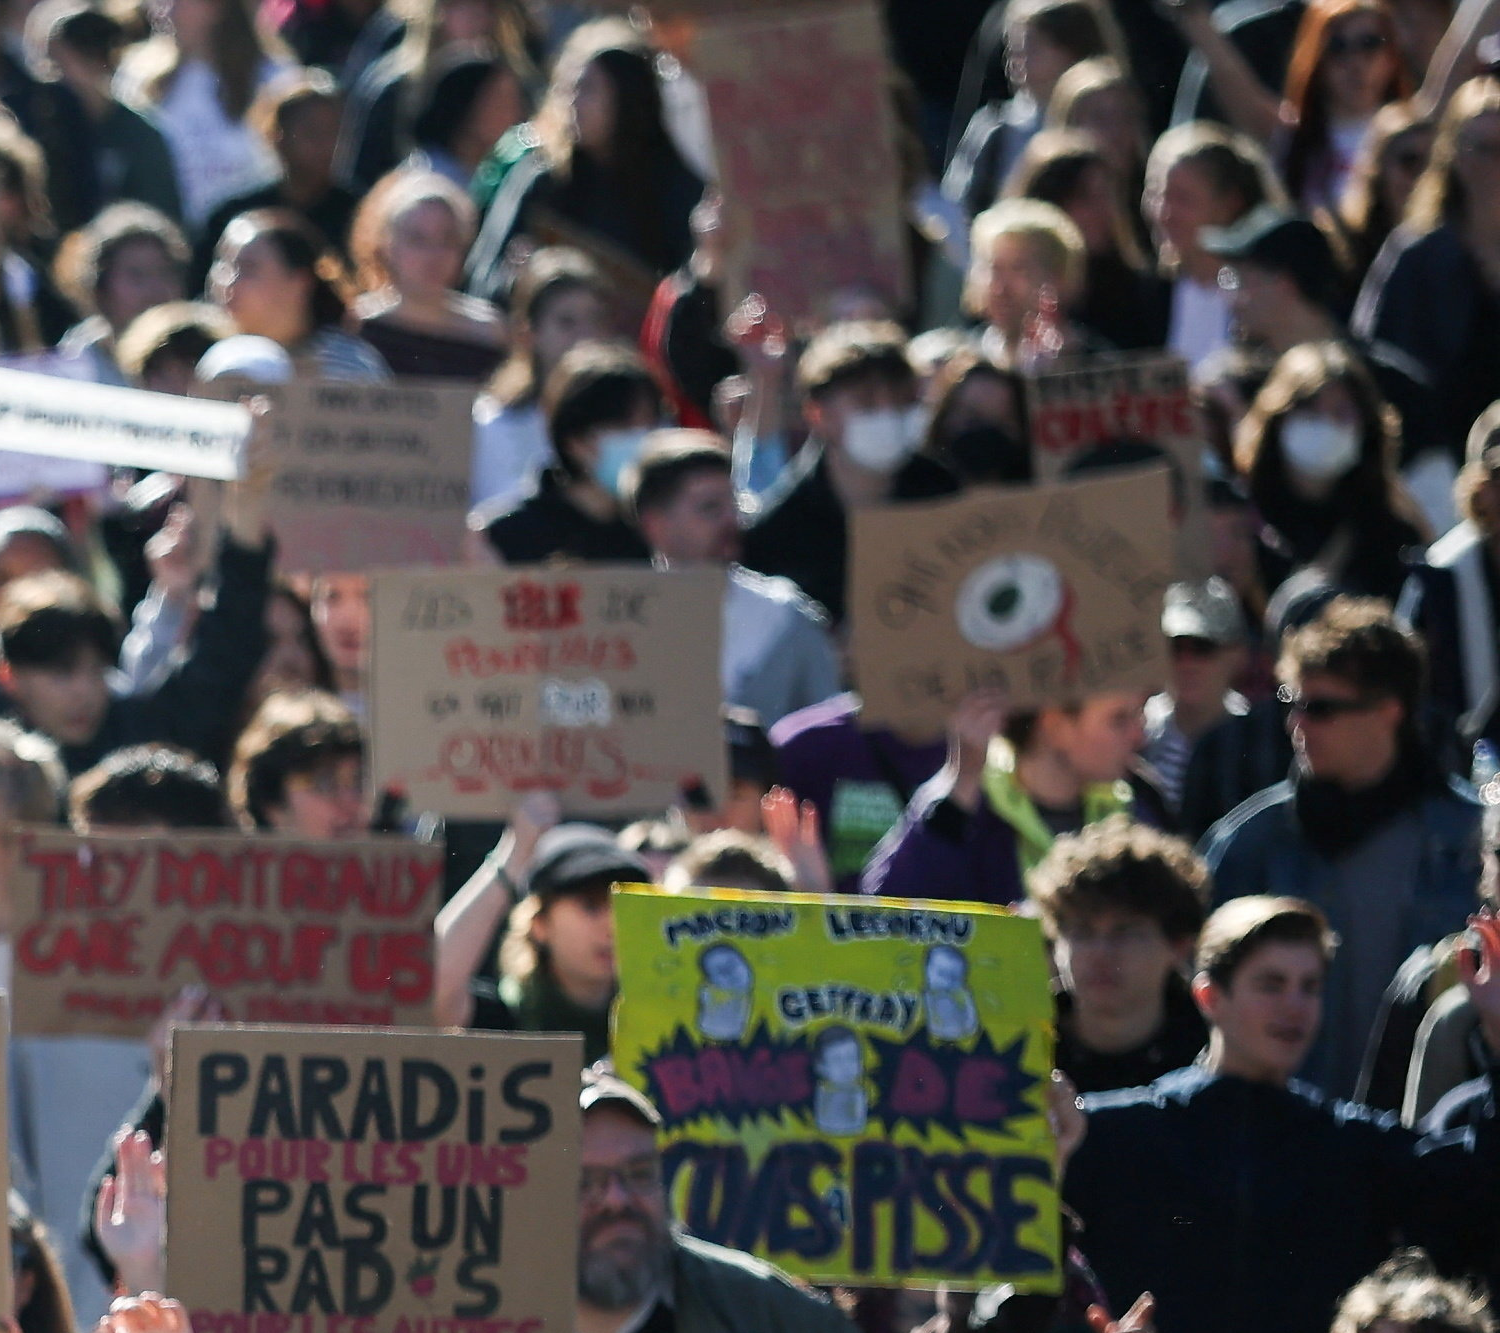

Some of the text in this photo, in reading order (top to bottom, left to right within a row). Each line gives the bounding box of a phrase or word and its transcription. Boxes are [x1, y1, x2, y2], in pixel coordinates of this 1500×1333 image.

[157, 921, 341, 990] ABOUT
[349, 929, 436, 1006] US
[889, 1044, 1009, 1121] DE
[205, 1136, 530, 1188] POUR LES UNS
[241, 1178, 504, 1255] PAS UN
[850, 1138, 1056, 1274] PISSE
